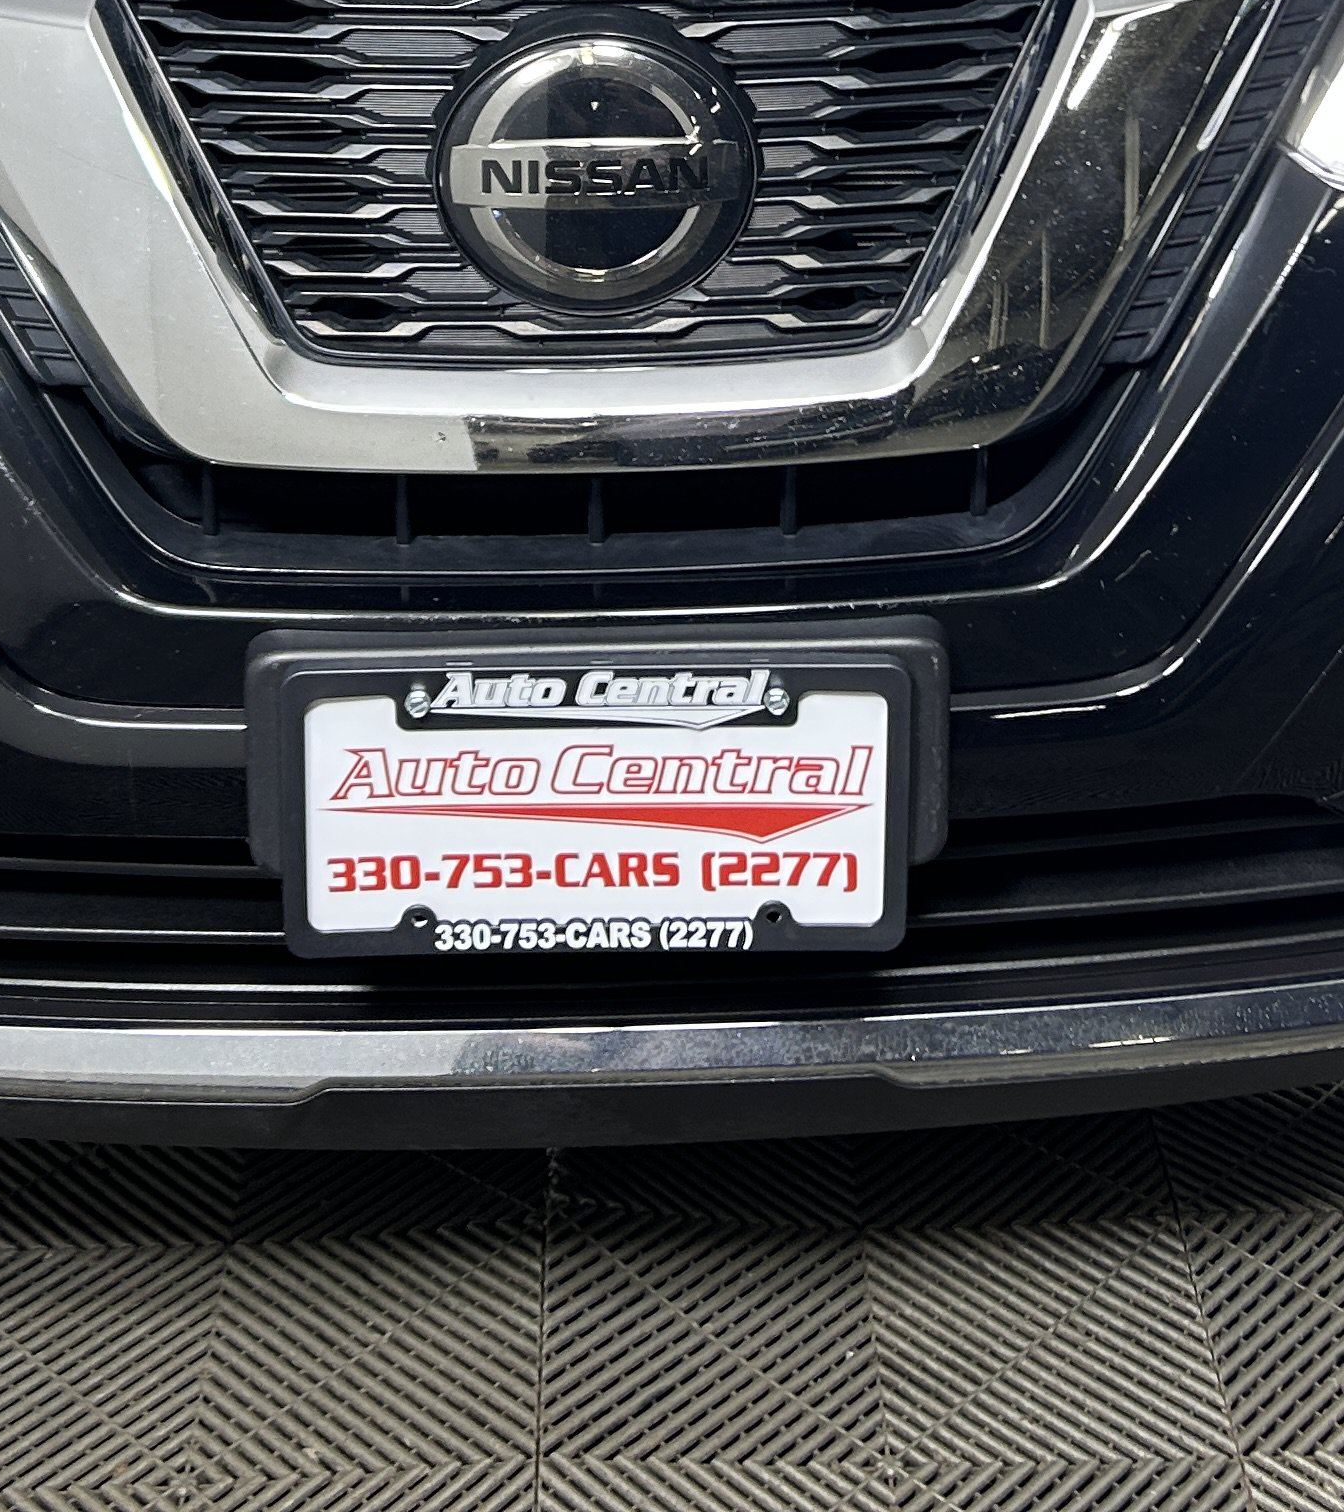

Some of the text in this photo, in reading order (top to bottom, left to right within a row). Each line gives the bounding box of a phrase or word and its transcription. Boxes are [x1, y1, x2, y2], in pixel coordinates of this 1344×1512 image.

[481, 158, 711, 196] NISSAN
[431, 669, 770, 707] Auto Central
[329, 744, 874, 801] Auto Central
[326, 851, 858, 893] 330-753-CARS (2277)
[433, 918, 754, 951] 330-753-CARS (2277)
